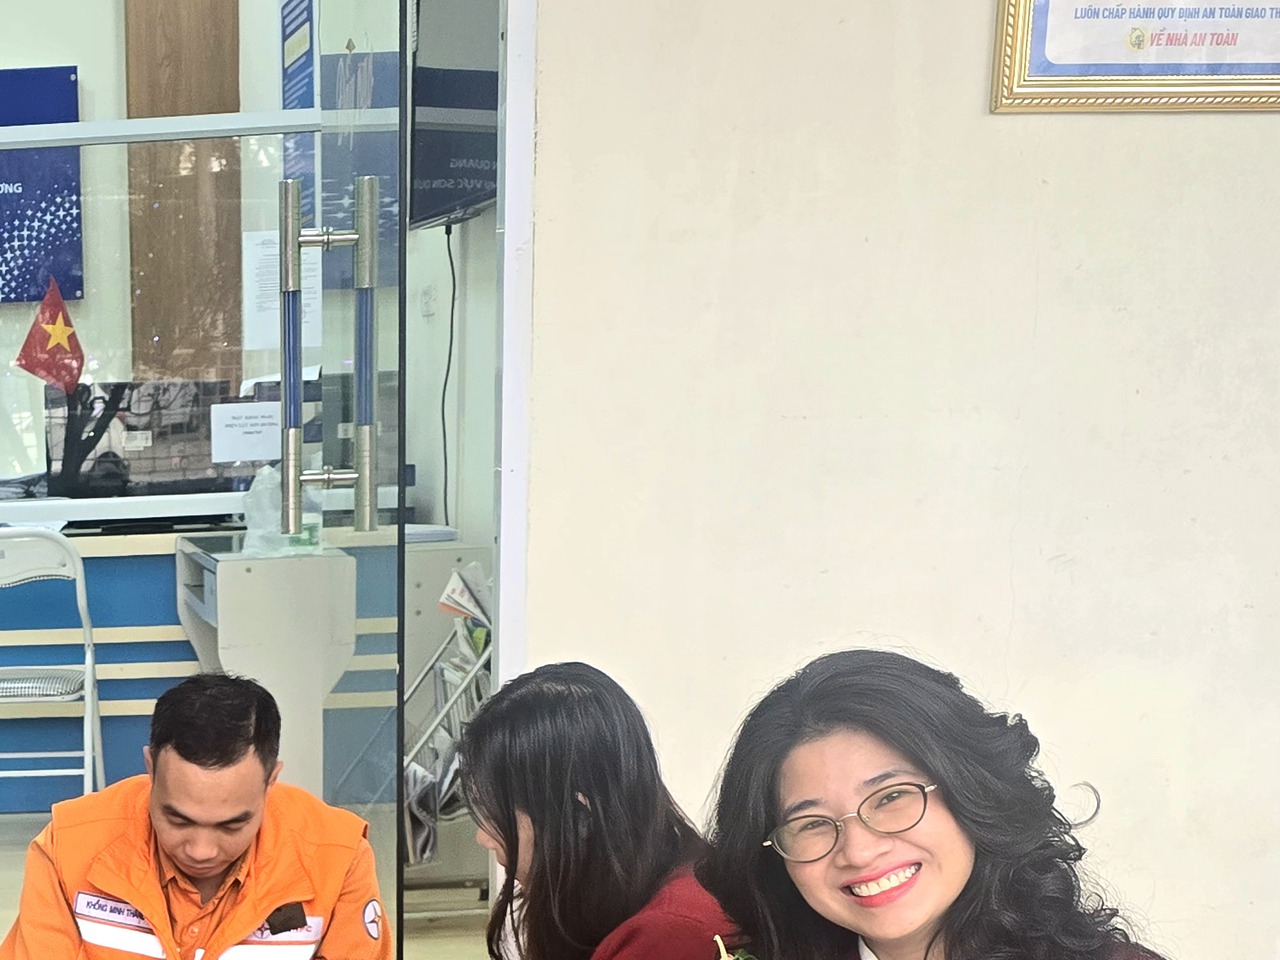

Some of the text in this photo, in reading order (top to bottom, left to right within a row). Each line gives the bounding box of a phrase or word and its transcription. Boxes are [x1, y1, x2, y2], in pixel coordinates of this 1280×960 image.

[1074, 5, 1100, 19] LUÔN
[1102, 3, 1127, 19] CHẤP
[1129, 4, 1155, 19] HÀNH
[1157, 7, 1177, 20] QUY
[1178, 7, 1200, 22] ĐỊNH
[1201, 7, 1216, 19] AN
[1219, 4, 1243, 19] TOÀN
[1245, 7, 1267, 19] GIAO
[1165, 29, 1188, 46] NHÀ
[1190, 32, 1207, 46] AN
[1209, 29, 1239, 46] TOÀN
